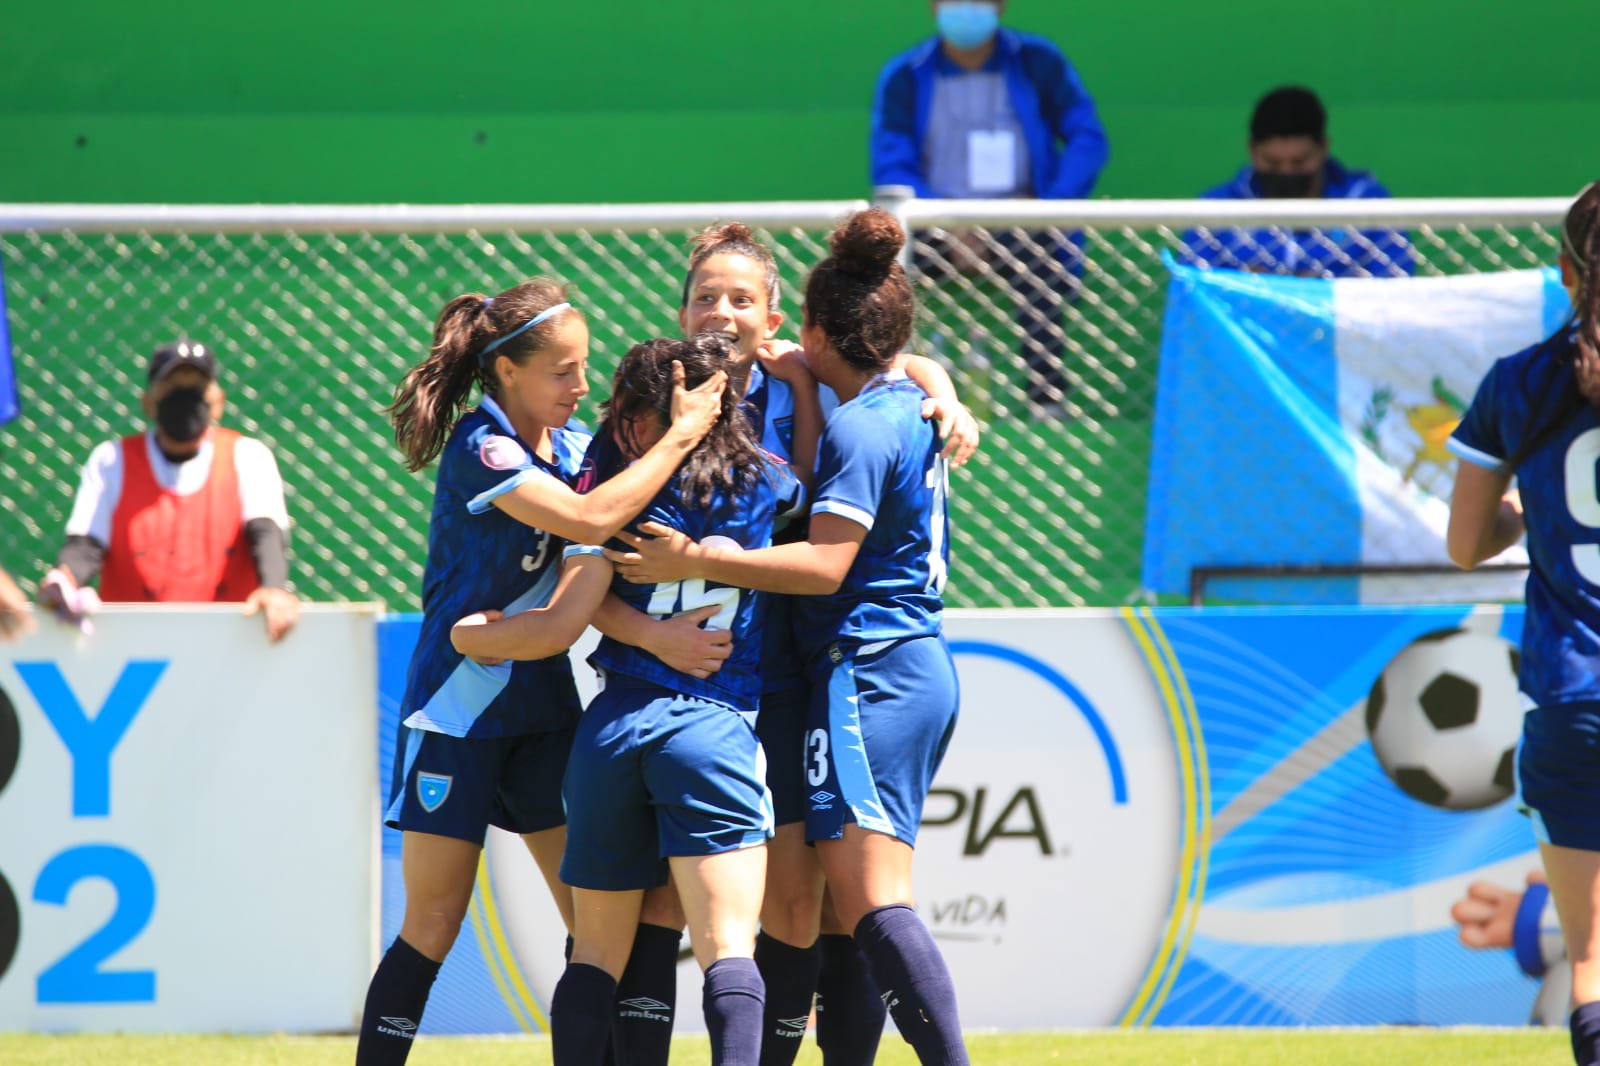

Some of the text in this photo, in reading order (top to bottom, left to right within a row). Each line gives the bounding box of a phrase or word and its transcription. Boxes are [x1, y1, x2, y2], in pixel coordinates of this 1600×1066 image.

[0, 658, 172, 818] Y
[0, 842, 157, 1006] 2
[619, 1010, 670, 1022] umbro
